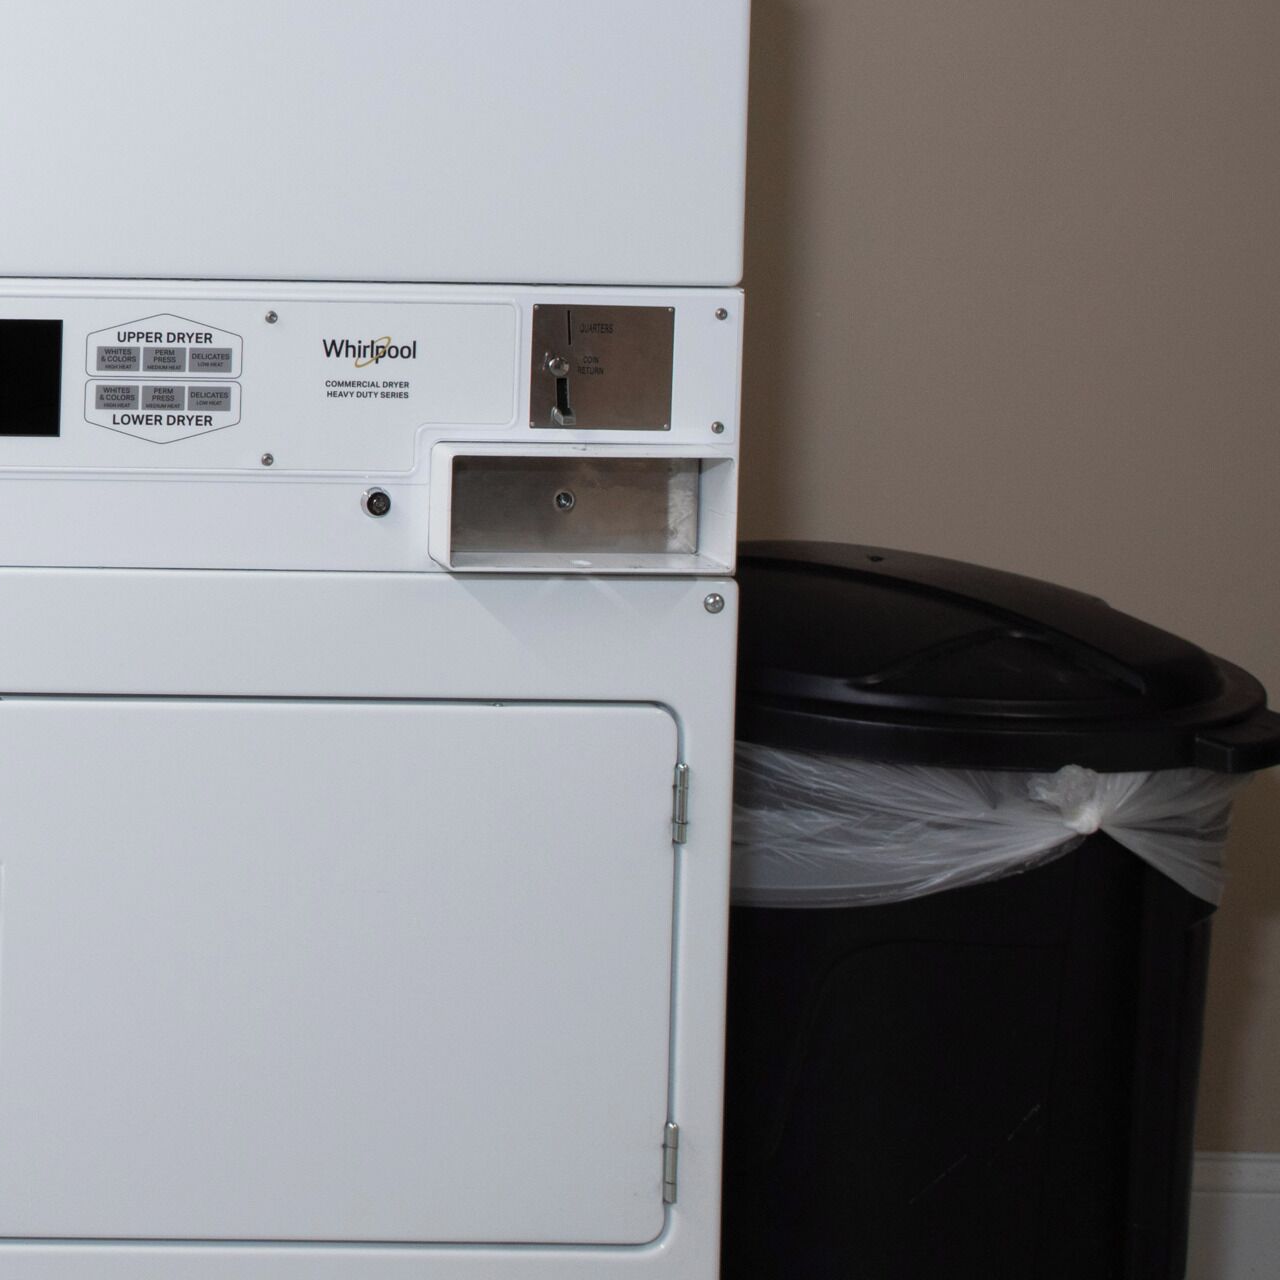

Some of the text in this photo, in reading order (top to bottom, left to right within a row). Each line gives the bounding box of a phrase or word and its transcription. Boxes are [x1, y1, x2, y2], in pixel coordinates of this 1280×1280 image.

[579, 323, 615, 334] QUARTERS
[117, 331, 213, 344] UPPER DRYER
[322, 338, 417, 365] Whirlpool
[583, 356, 600, 364] COIN
[577, 366, 604, 376] RETURN
[325, 380, 410, 389] COMMERCIAL DRYER
[326, 390, 409, 399] HEAVY DUTY SERIES
[112, 414, 213, 426] LOWER DRYER
